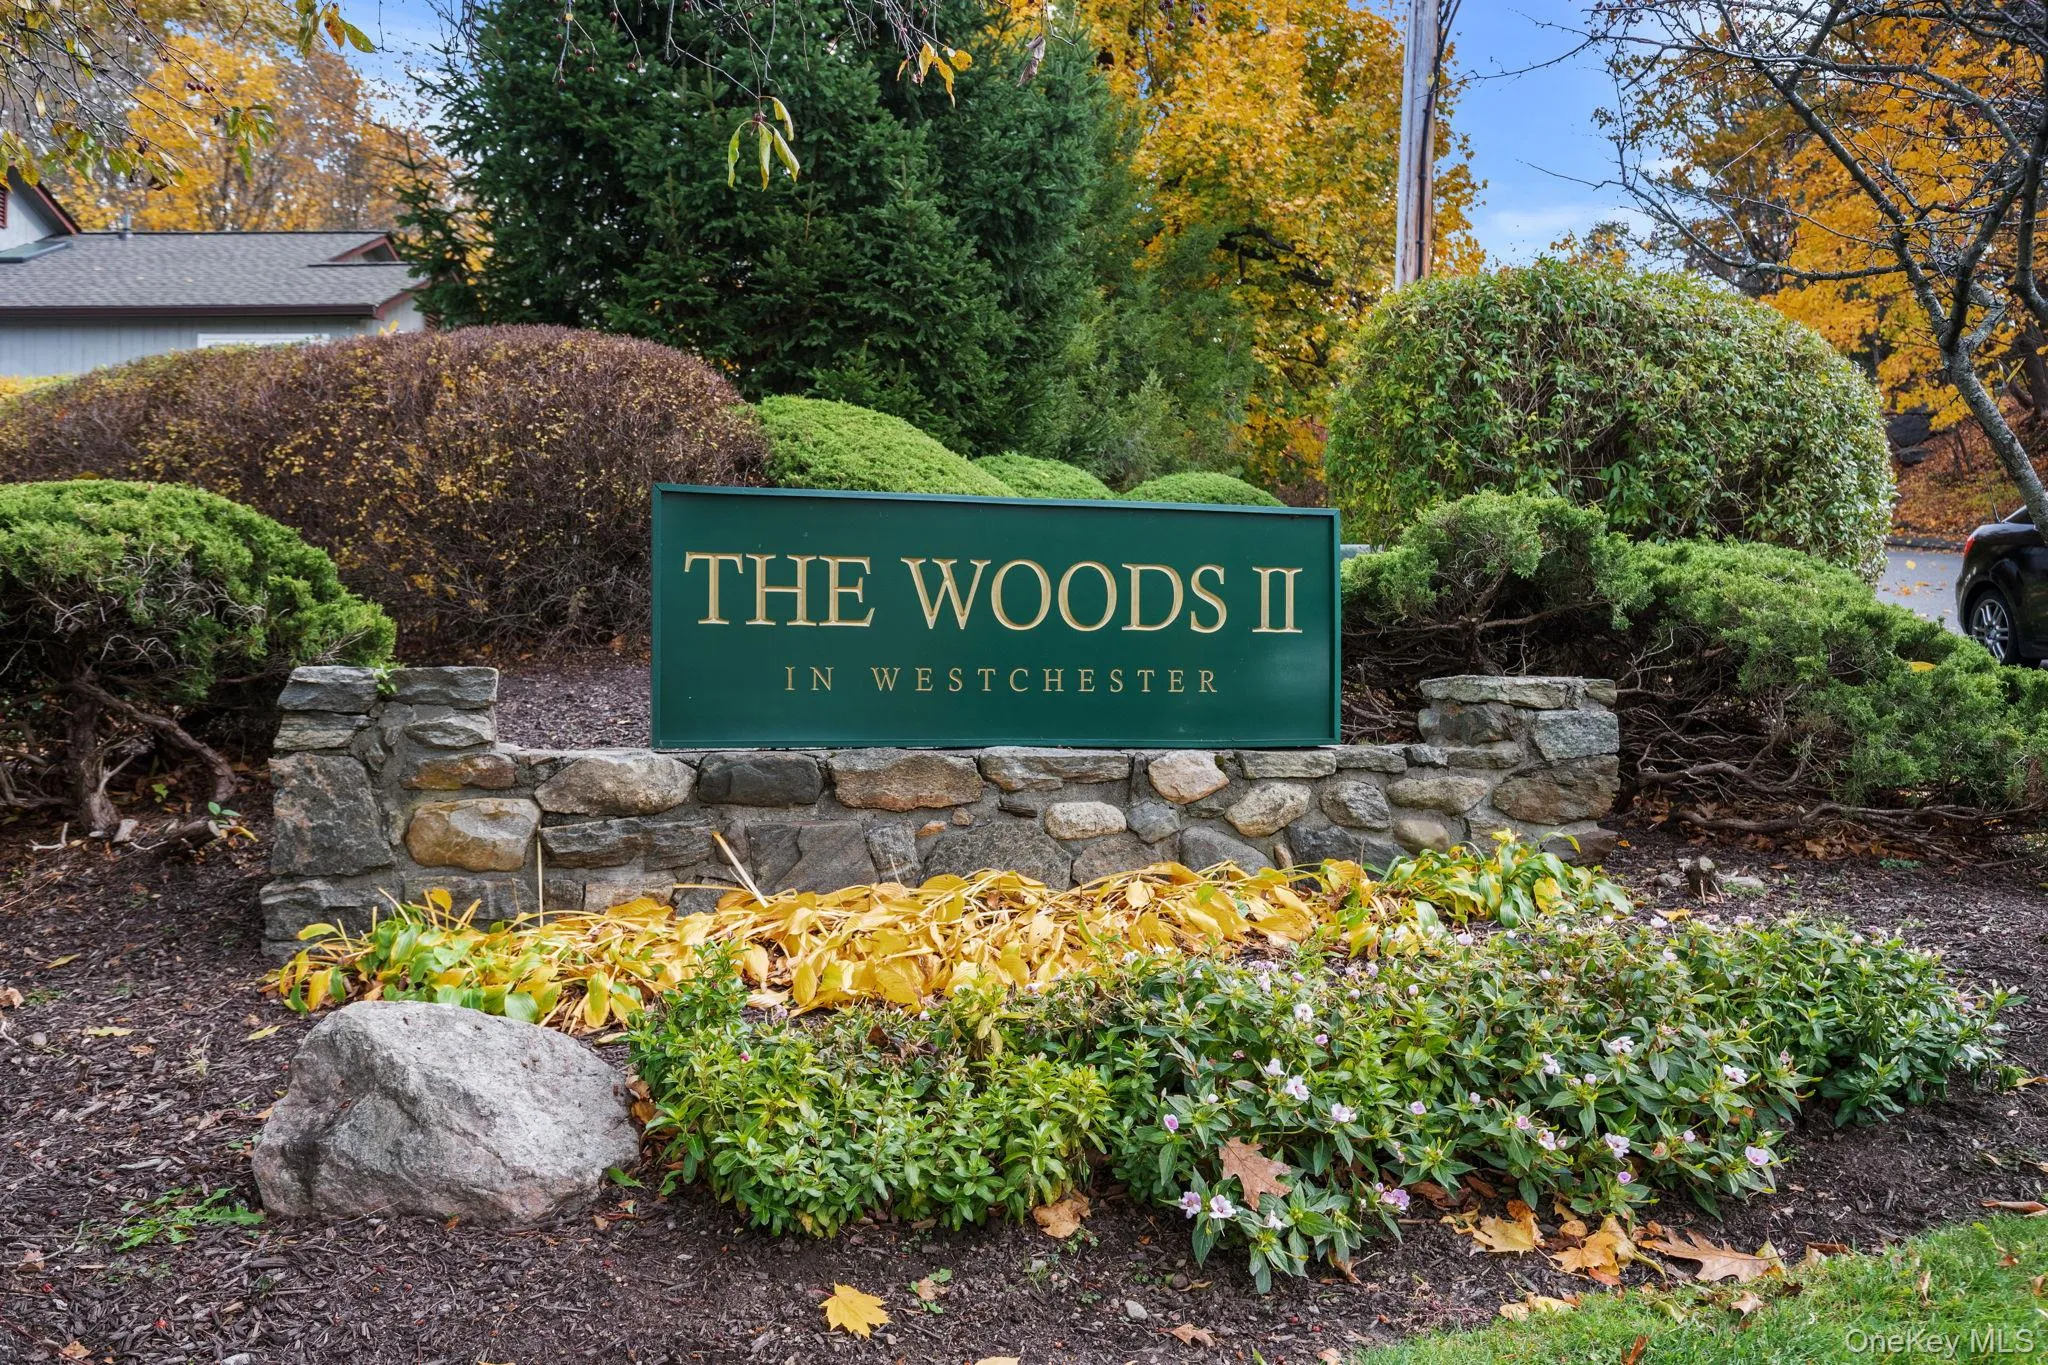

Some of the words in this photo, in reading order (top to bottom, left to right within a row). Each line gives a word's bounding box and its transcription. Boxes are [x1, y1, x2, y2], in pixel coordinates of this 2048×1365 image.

[684, 551, 876, 628] THE
[900, 557, 1227, 634] WOODS
[1252, 566, 1303, 634] II
[785, 666, 833, 692] IN
[870, 666, 1219, 693] WESTCHESTER
